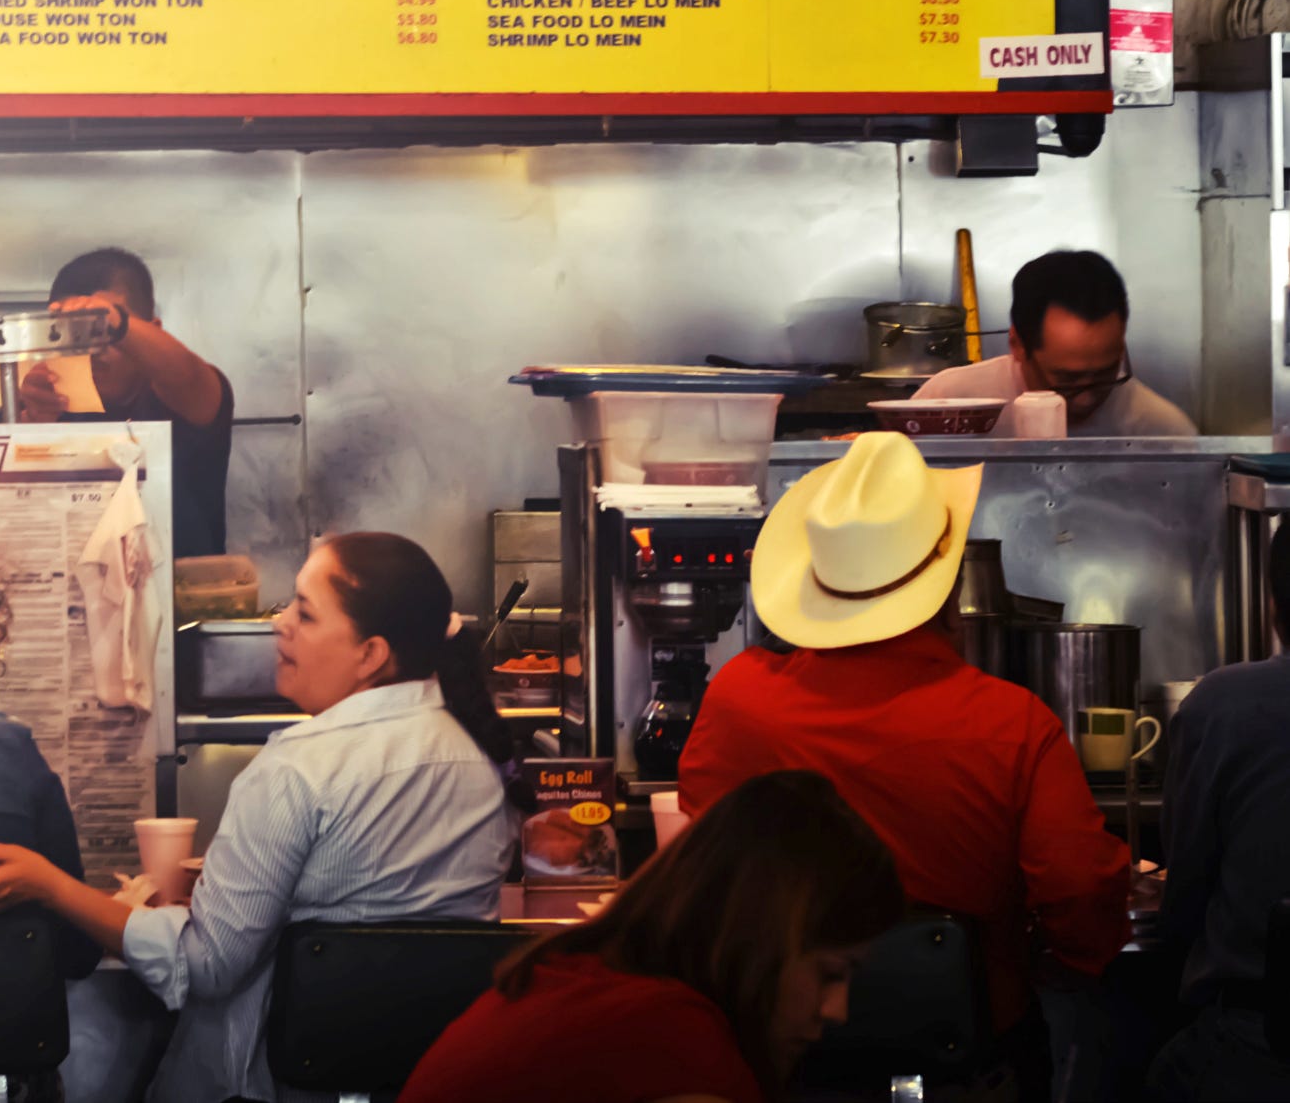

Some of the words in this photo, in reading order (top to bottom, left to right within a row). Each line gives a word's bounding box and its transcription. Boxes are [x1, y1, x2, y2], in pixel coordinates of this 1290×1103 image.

[46, 13, 89, 26] WON
[97, 13, 136, 26] TON
[488, 15, 525, 28] SEA
[533, 15, 583, 28] FOOD
[590, 15, 614, 28] LO
[621, 15, 666, 28] MEIN
[919, 12, 960, 25] $7.30
[19, 32, 69, 45] FOOD
[78, 32, 121, 45] WON
[128, 32, 167, 45] TON
[488, 34, 558, 47] SHRIMP
[565, 34, 589, 47] LO
[596, 34, 641, 46] MEIN
[920, 31, 960, 44] $7.30
[990, 47, 1038, 67] CASH
[1047, 44, 1092, 65] ONLY
[540, 771, 563, 787] Egg
[567, 770, 593, 784] Roll
